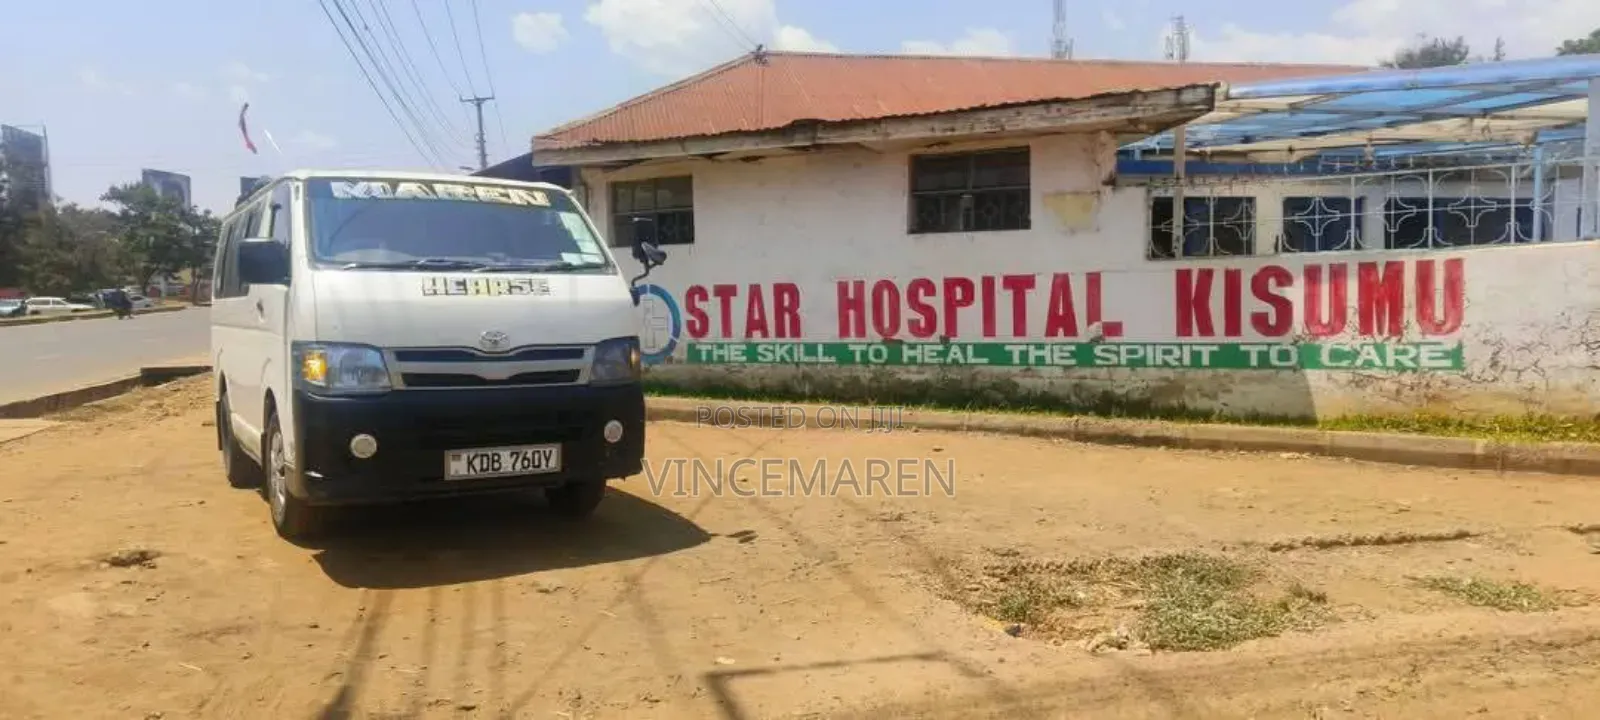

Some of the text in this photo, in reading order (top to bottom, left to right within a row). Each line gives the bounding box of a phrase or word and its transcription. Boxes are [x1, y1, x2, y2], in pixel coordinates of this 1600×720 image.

[330, 181, 550, 206] MAREN
[422, 277, 551, 296] HEARSE
[685, 258, 1465, 339] STAR HOSPITAL KISUMU
[700, 343, 1452, 368] THE SKILL TO HEAL THE SPIRIT TO CARE
[466, 448, 553, 474] KDB 760Y
